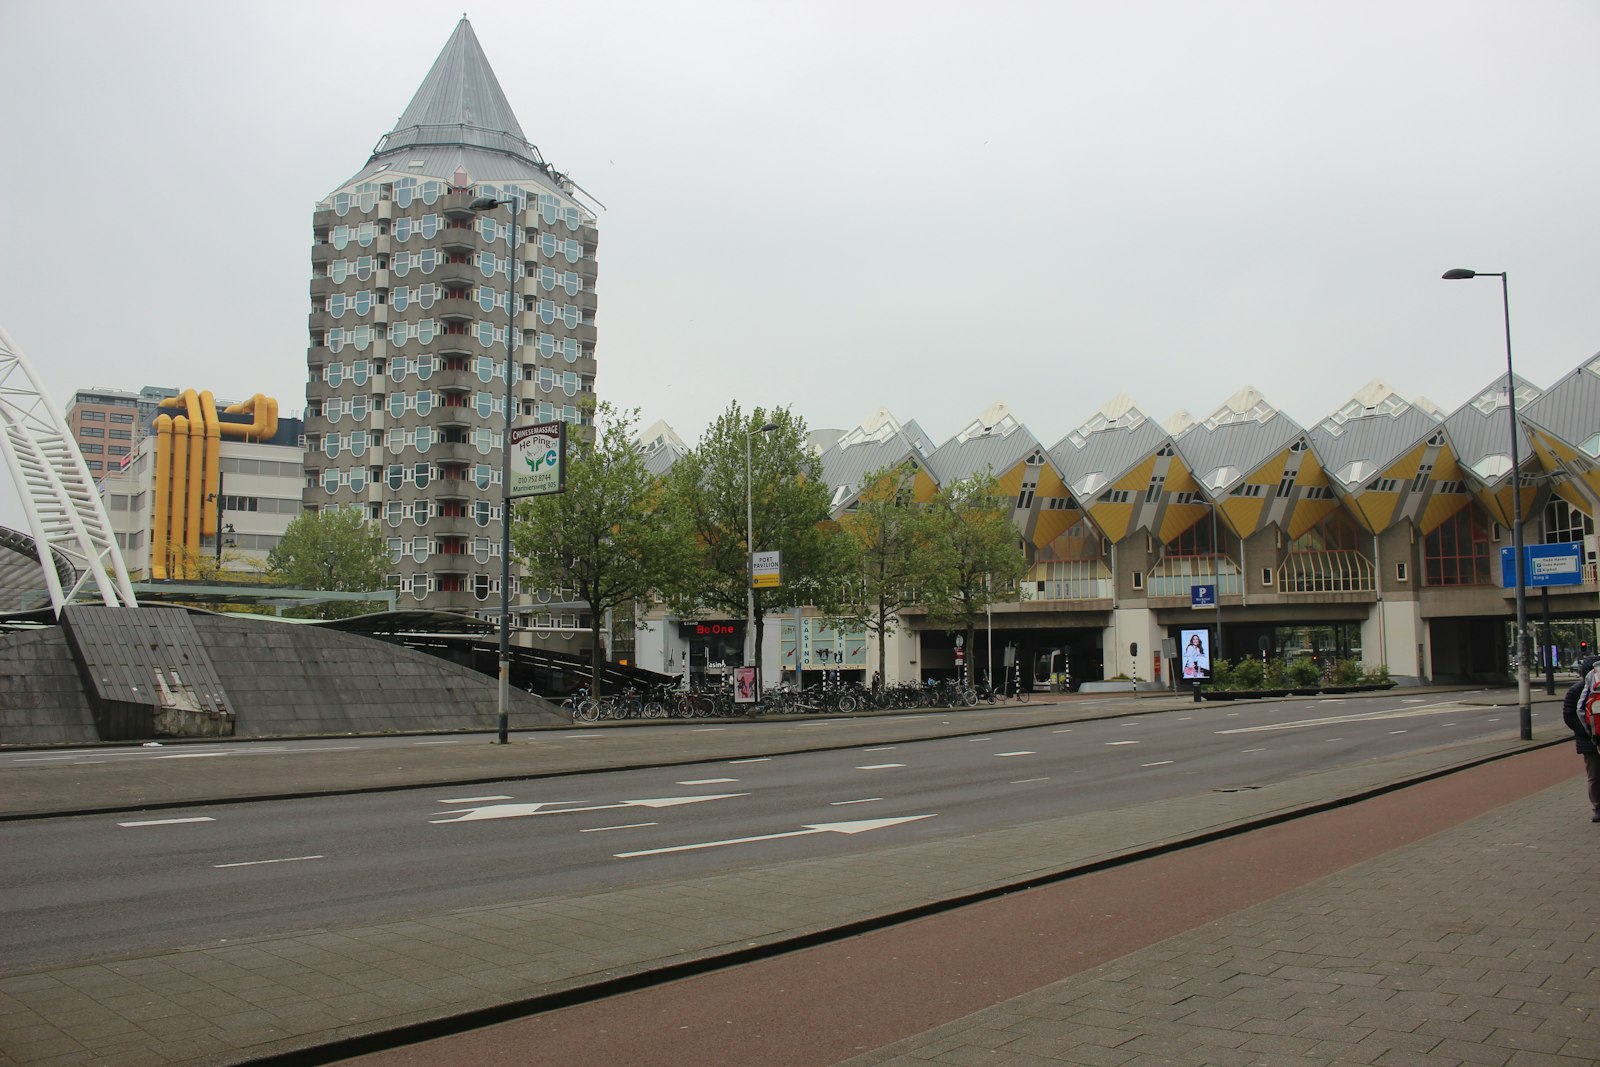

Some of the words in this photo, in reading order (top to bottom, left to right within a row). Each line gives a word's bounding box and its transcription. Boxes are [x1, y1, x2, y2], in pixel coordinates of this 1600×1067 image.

[520, 440, 531, 451] He
[528, 475, 538, 483] 752
[1199, 587, 1206, 597] P
[696, 624, 710, 635] Be
[712, 624, 735, 635] One
